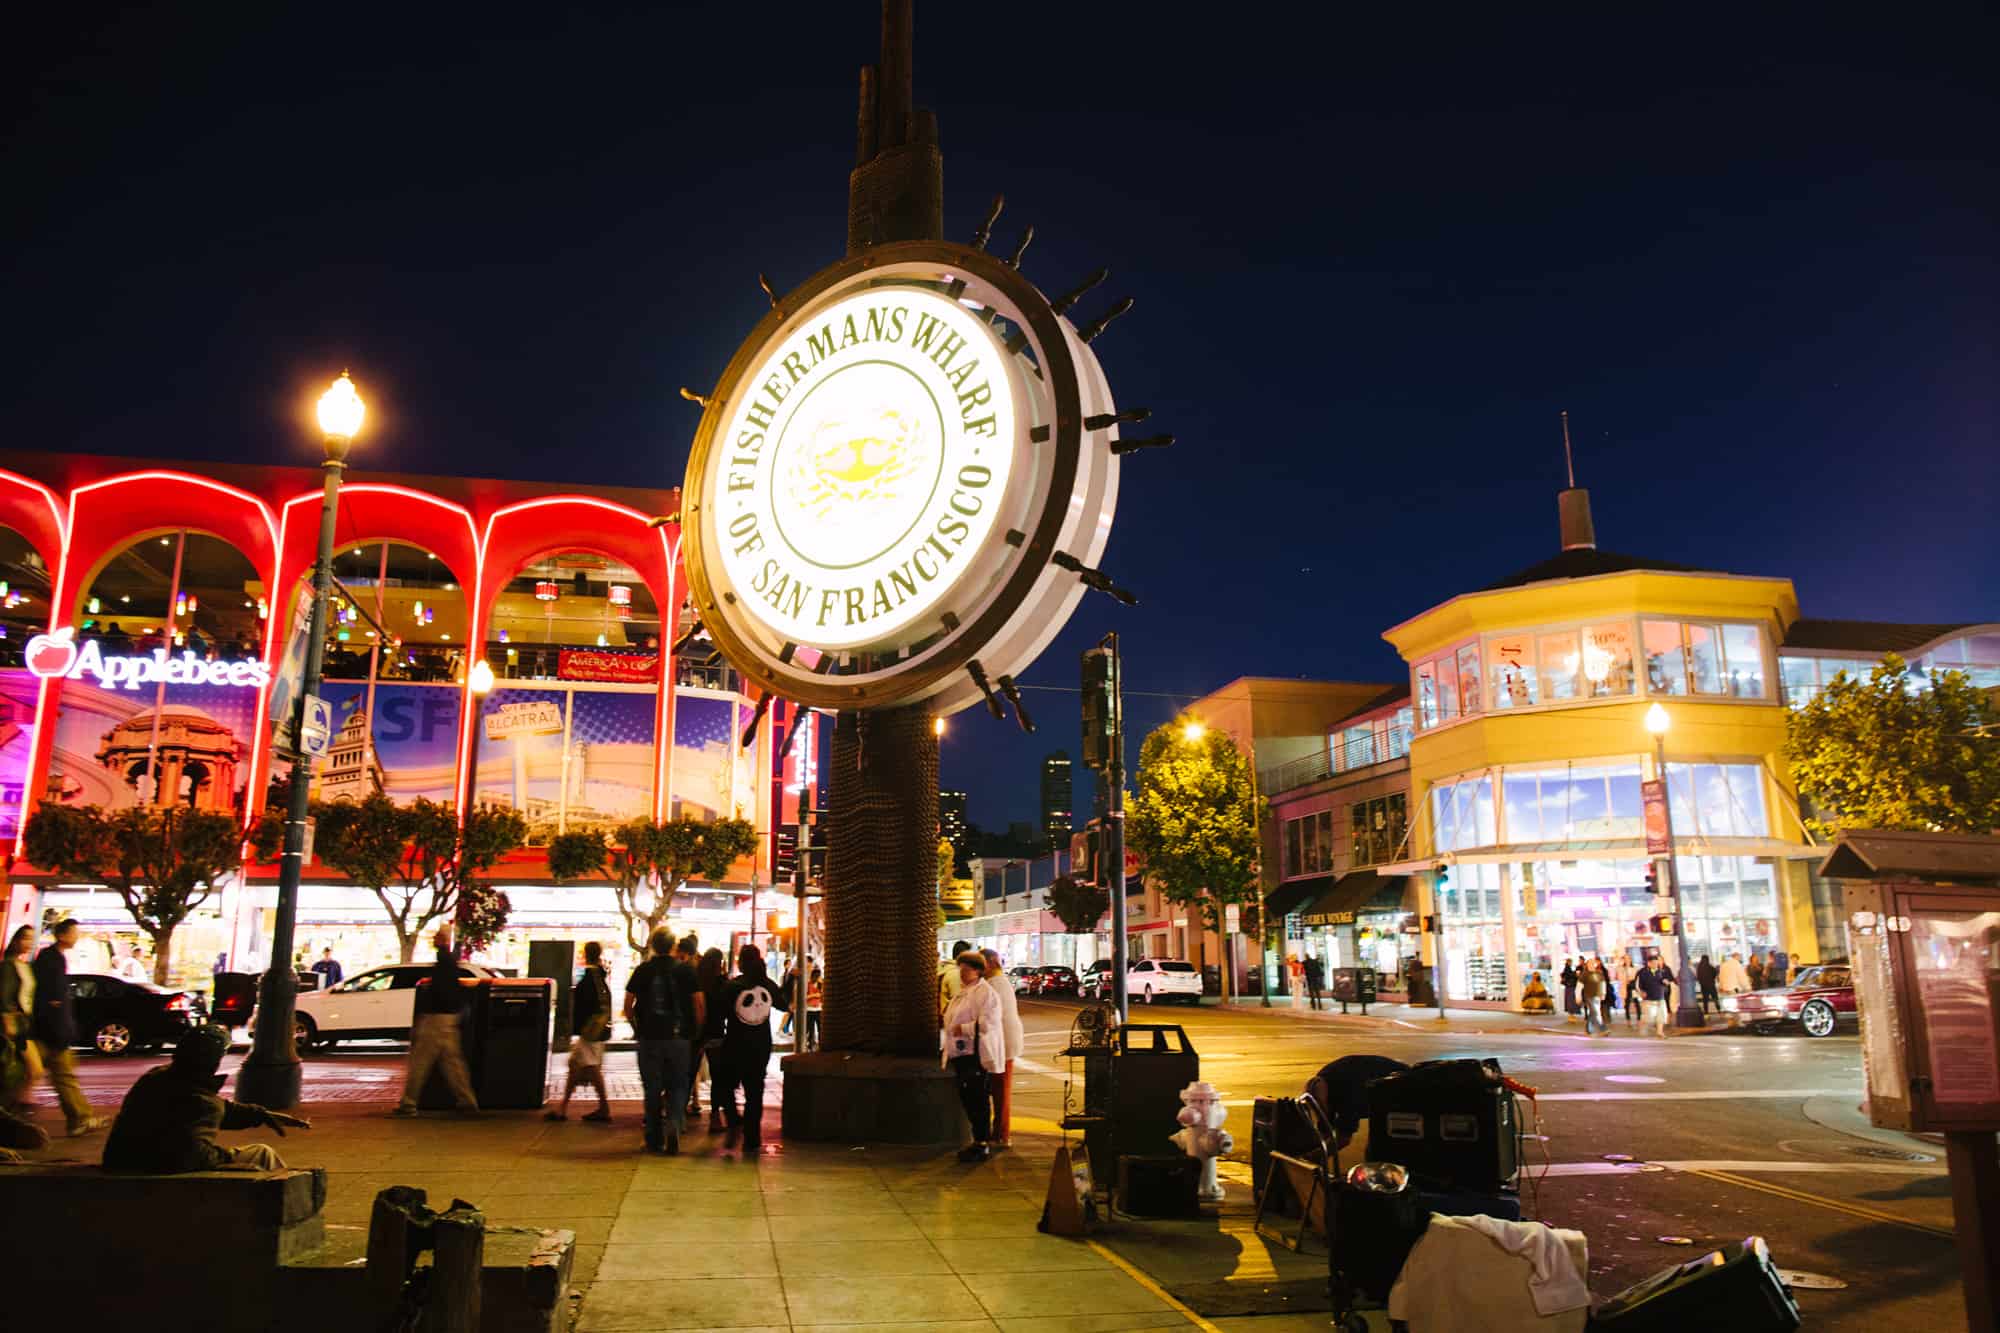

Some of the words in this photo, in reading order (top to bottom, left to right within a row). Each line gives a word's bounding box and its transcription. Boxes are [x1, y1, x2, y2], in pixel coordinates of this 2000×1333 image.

[727, 305, 909, 496] FISHERMANS
[909, 311, 997, 439] WHARF
[728, 519, 766, 558] OF
[751, 558, 813, 626] SAN
[816, 465, 991, 626] FRANCISCO
[67, 639, 271, 689] Applebee's
[380, 697, 455, 742] SF
